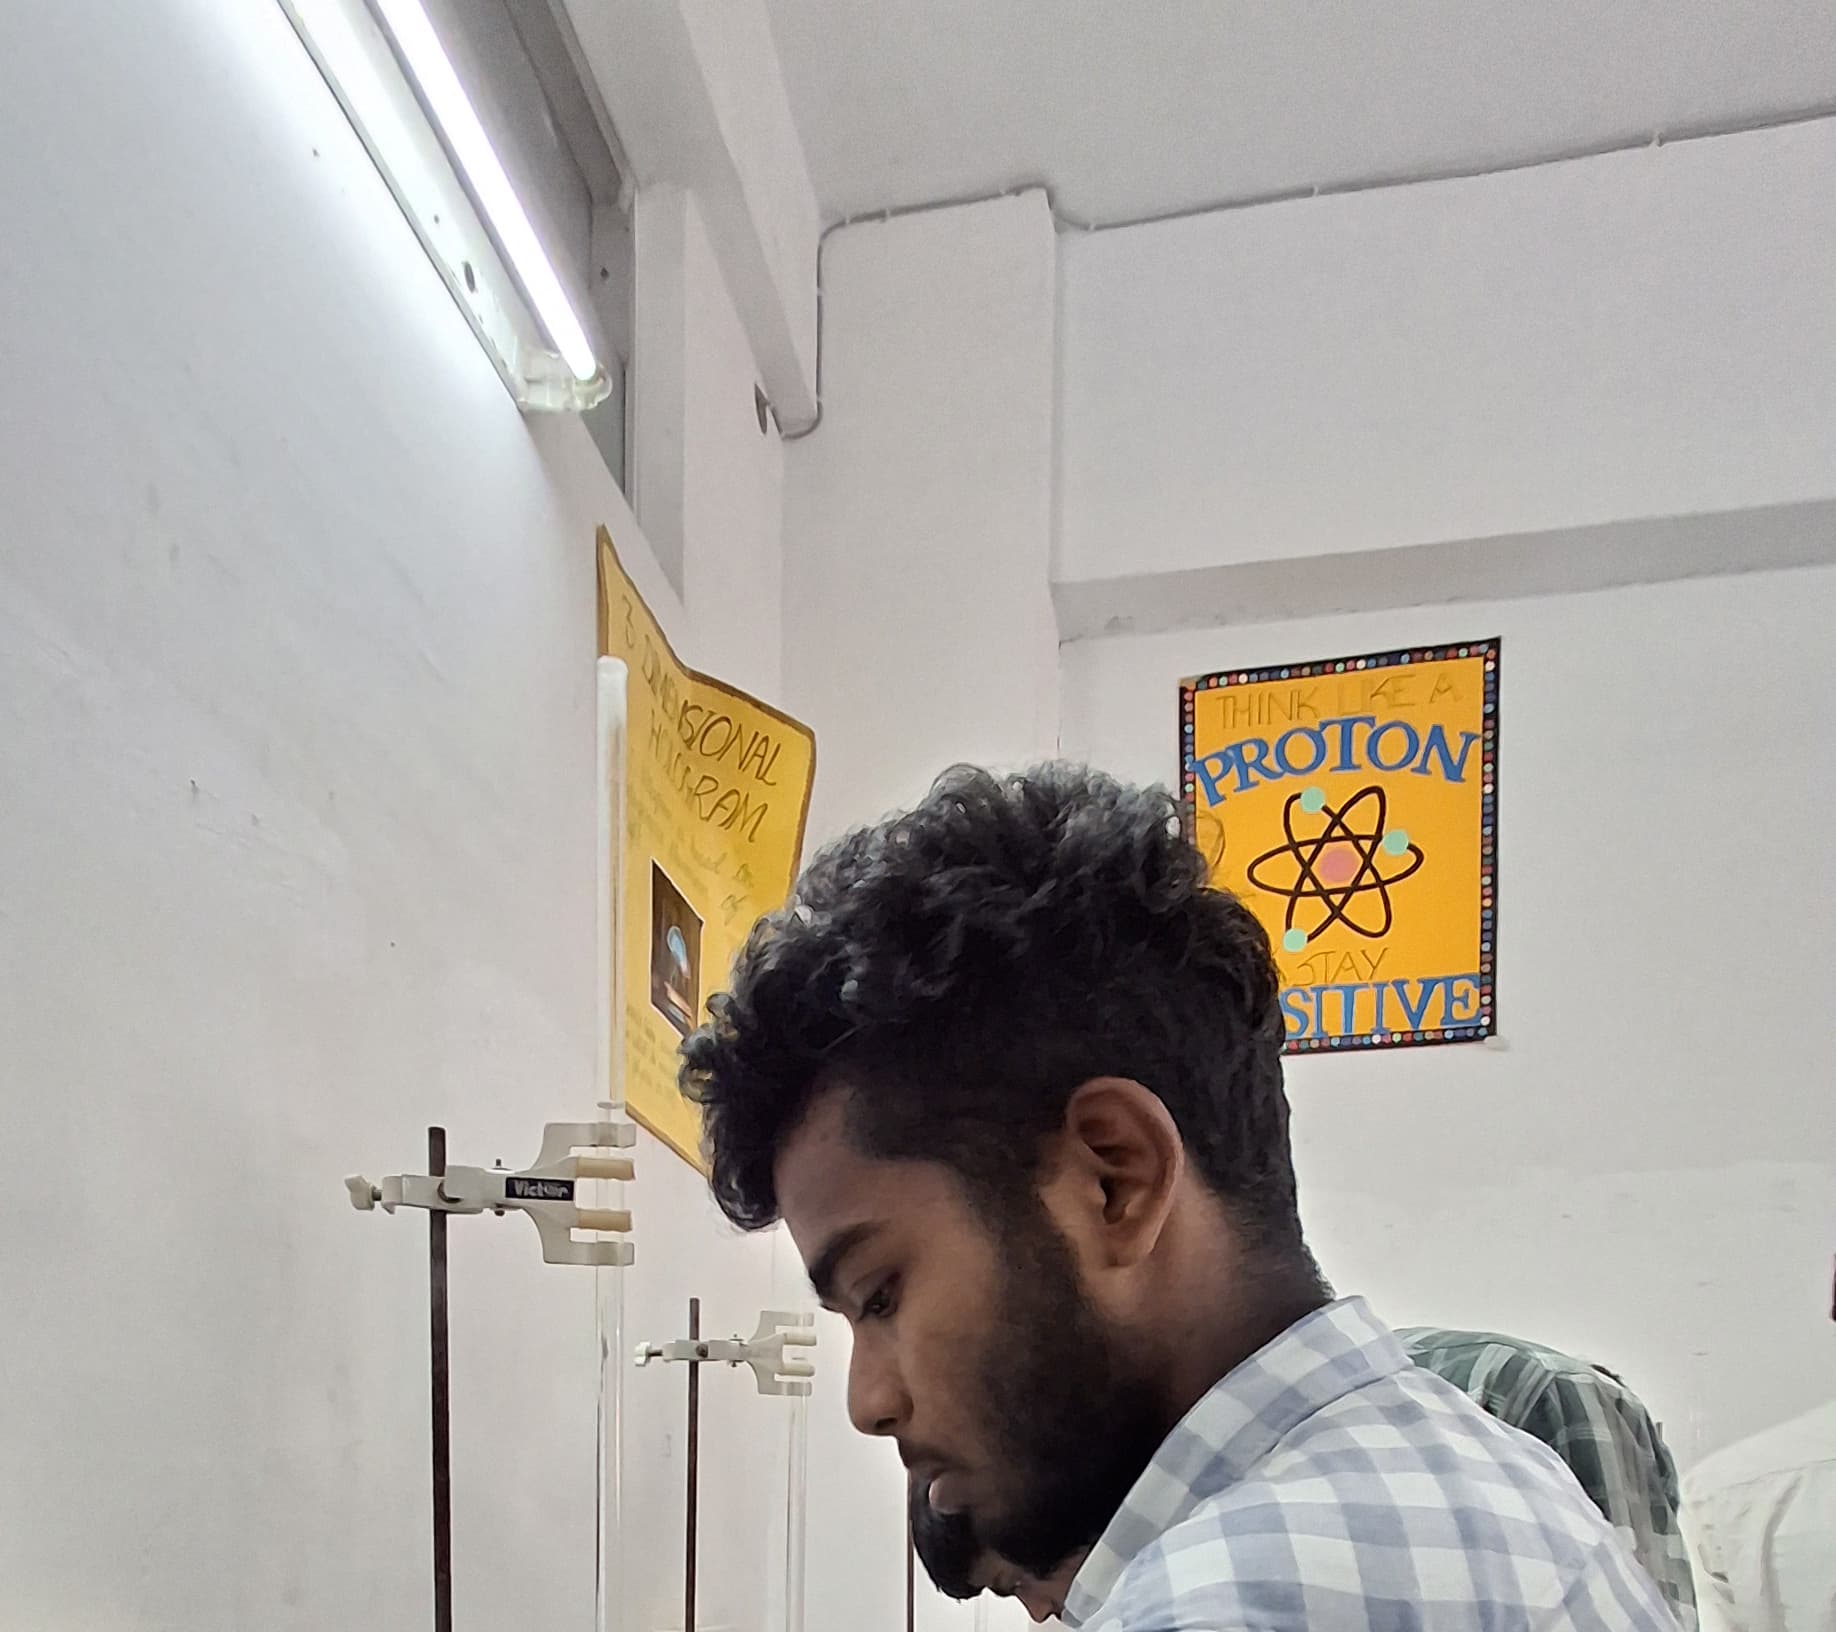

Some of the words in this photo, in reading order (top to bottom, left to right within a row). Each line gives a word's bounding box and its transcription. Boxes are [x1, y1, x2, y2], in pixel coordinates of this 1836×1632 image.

[1216, 686, 1320, 730] THINK
[1337, 674, 1416, 718] LIKE
[1428, 672, 1464, 706] A
[1192, 715, 1481, 808] PROTON
[1288, 947, 1389, 987] STAY
[1279, 972, 1483, 1041] SITIVE
